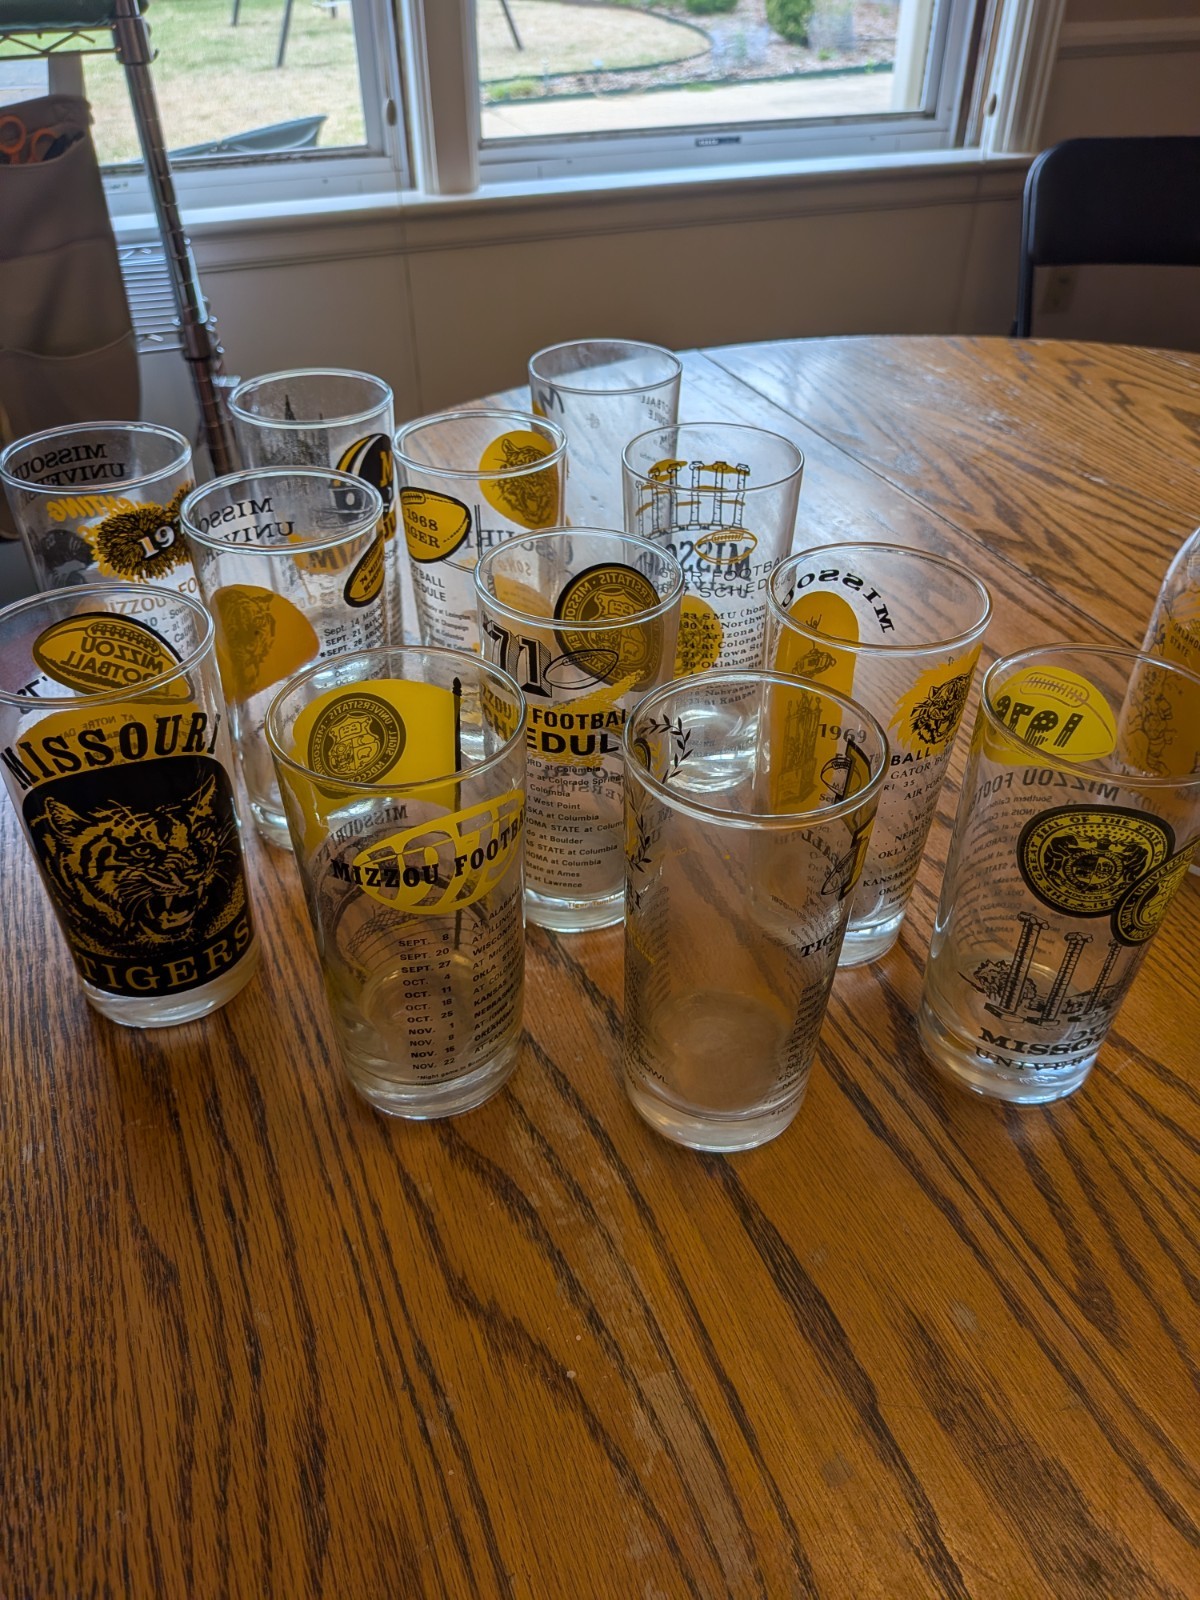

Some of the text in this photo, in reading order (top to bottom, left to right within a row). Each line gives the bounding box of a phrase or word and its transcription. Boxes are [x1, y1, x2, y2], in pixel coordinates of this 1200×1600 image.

[406, 508, 438, 532] 1968
[326, 629, 362, 646] SEPT. 21
[703, 628, 754, 640] Arizona
[701, 652, 759, 669] Oklahoma
[719, 648, 747, 659] Iowa
[2, 712, 221, 790] MISSOURI
[891, 747, 931, 766] BALL
[557, 765, 601, 774] Columbia
[890, 762, 931, 780] GATOR
[548, 776, 589, 786] Colorado
[903, 779, 915, 788] 35
[530, 783, 571, 798] Columbia
[904, 788, 923, 800] AIR
[533, 796, 581, 811] West Point
[546, 812, 555, 820] at
[558, 812, 600, 822] Columbia
[551, 824, 580, 833] STATE
[1038, 820, 1064, 839] SEAL
[1070, 816, 1089, 824] OF
[1101, 817, 1131, 827] THE
[1135, 825, 1161, 847] STATE
[549, 835, 584, 845] Boulder
[537, 843, 565, 855] STATE
[579, 844, 618, 856] Columbia
[561, 859, 602, 867] Columbia
[331, 859, 439, 889] MIZZOU
[543, 877, 583, 888] Lawrence
[398, 938, 431, 947] SEPT.
[442, 933, 449, 941] 8
[473, 919, 484, 930] AT
[76, 917, 250, 991] TIGERS
[400, 952, 431, 961] SEPT.
[435, 947, 450, 957] 20
[472, 932, 484, 944] AT
[401, 965, 434, 974] SEPT.
[438, 960, 451, 969] 27
[403, 978, 429, 987] OCT.
[473, 959, 484, 970] AT
[404, 991, 432, 999] OCT.
[473, 964, 497, 982] OKLA
[405, 984, 485, 1011] OCT. 18 AT
[407, 979, 507, 1023] OCT. 25 KANSAS
[409, 1027, 436, 1035] NOV.
[474, 1021, 484, 1031] AT
[411, 1050, 437, 1059] NOV.
[445, 1046, 455, 1054] 15
[413, 1043, 484, 1070] NOV. 22 AT
